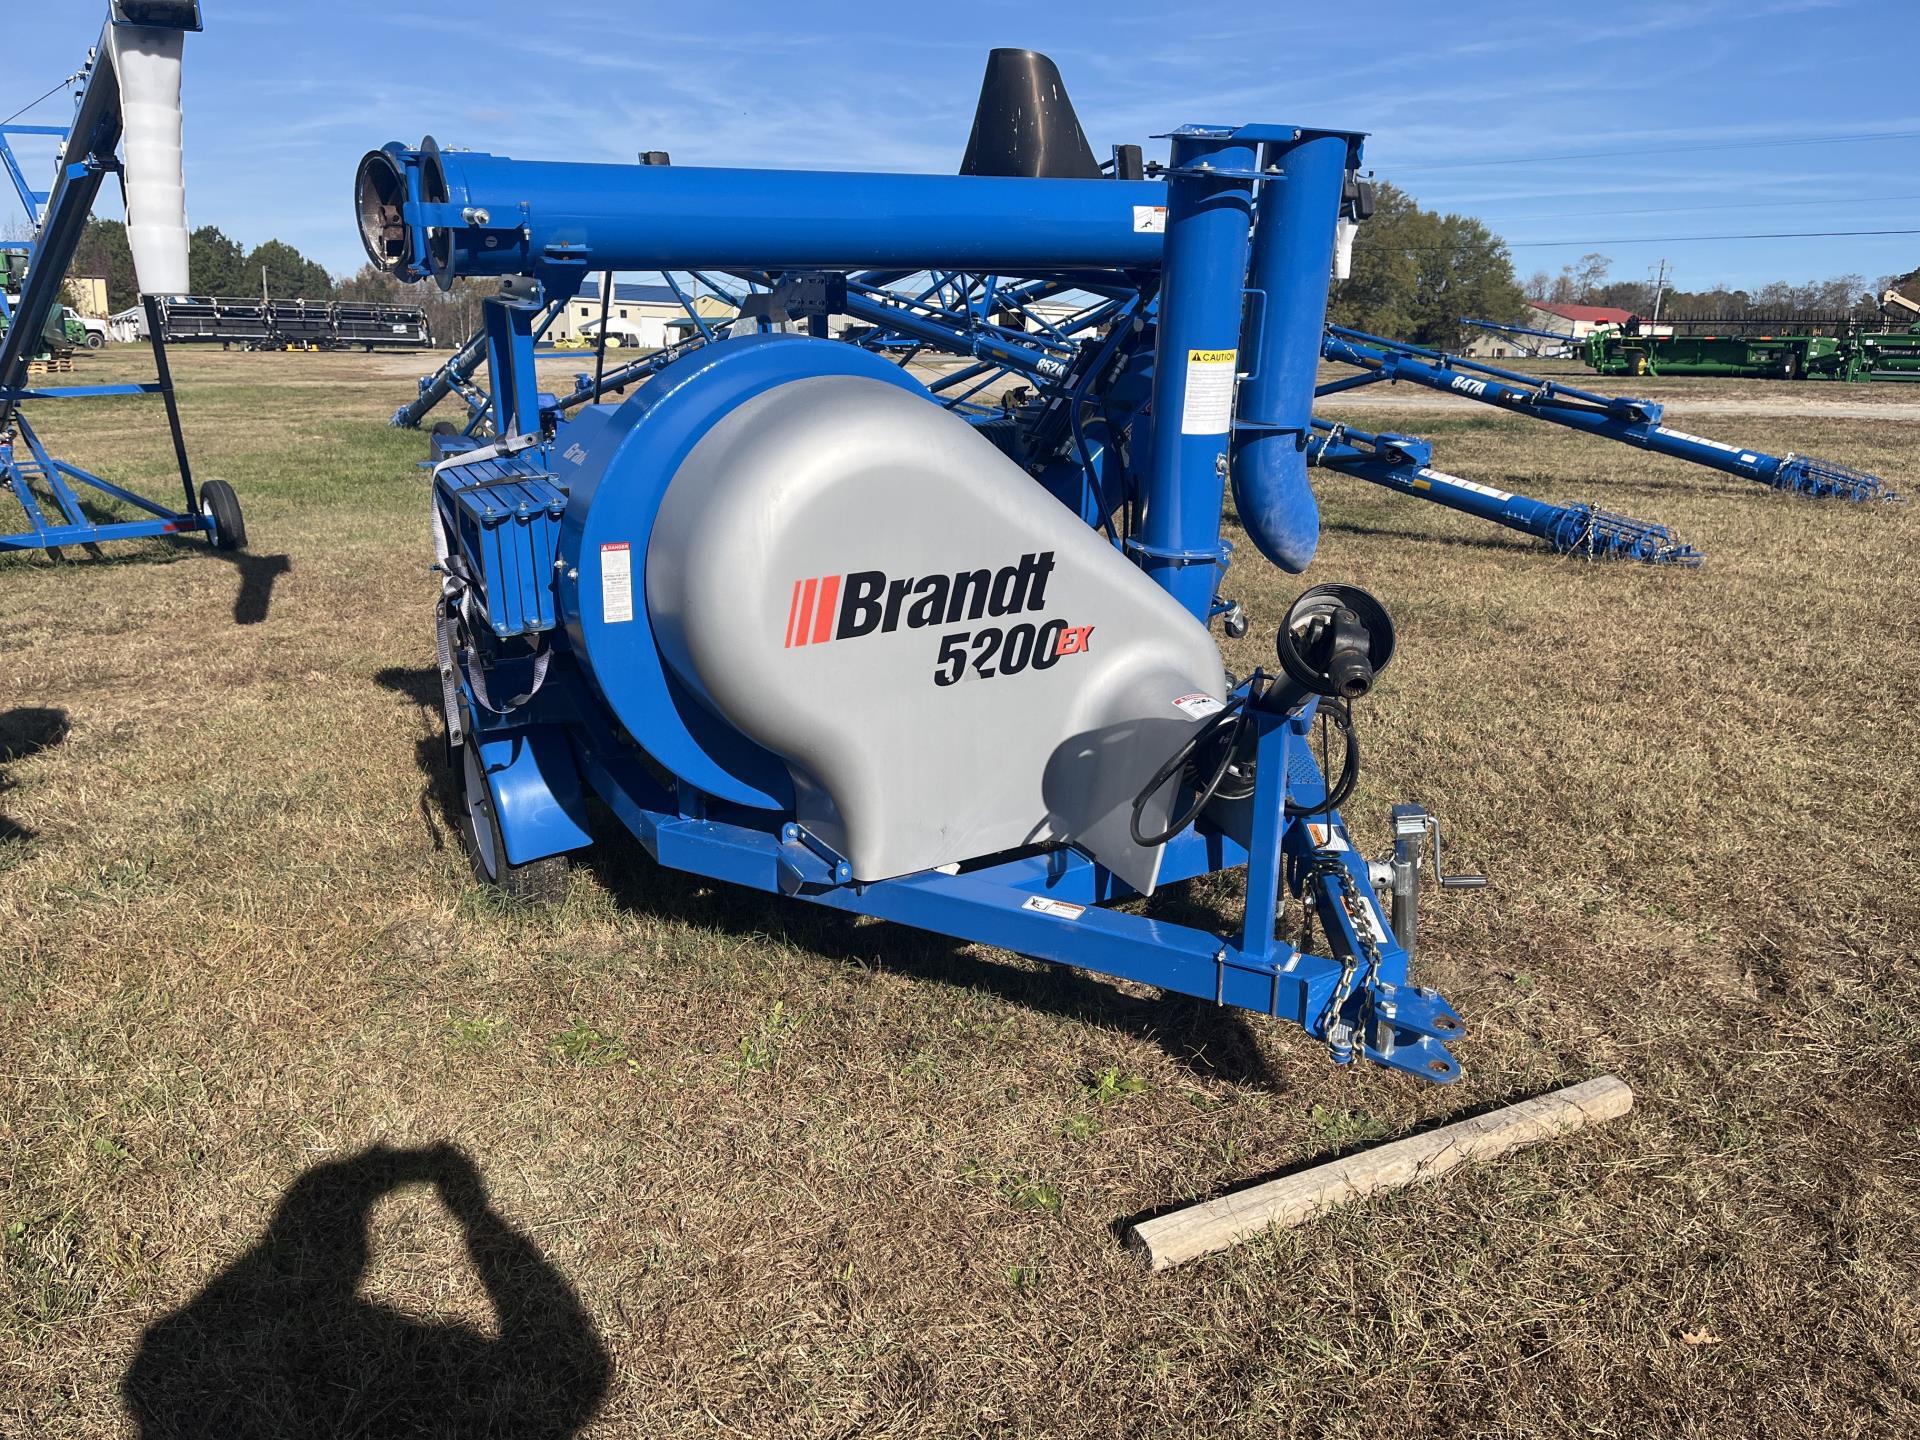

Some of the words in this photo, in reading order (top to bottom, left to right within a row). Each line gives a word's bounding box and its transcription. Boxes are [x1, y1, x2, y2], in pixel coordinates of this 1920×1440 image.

[1202, 353, 1235, 361] CAUTION
[1451, 376, 1487, 396] 847A
[836, 551, 1056, 641] Brandt
